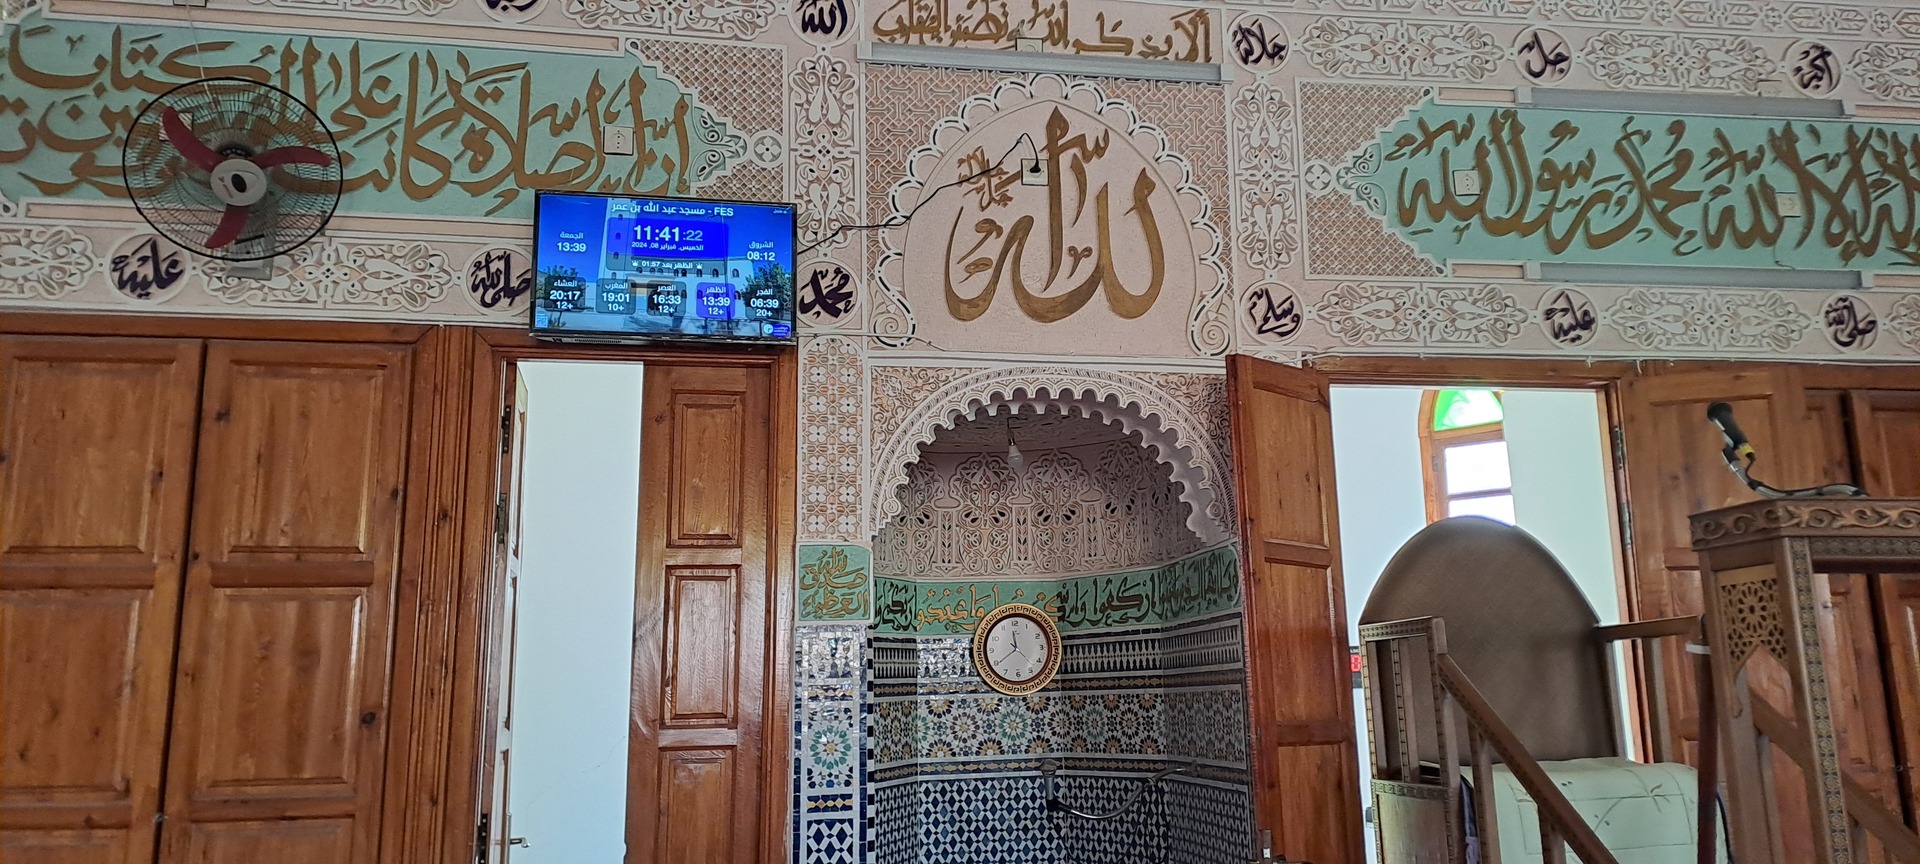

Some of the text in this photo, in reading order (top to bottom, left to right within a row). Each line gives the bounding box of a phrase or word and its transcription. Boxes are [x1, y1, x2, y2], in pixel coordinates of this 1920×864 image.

[611, 203, 628, 212] عمر
[630, 204, 641, 214] بن
[644, 202, 659, 214] الله
[661, 205, 677, 214] عبد
[678, 205, 706, 216] مسجد
[714, 208, 734, 217] FES
[944, 105, 1165, 323] الله
[560, 231, 584, 240] الجمعة
[557, 242, 587, 252] 13:39
[749, 241, 774, 250] الشروق
[747, 251, 776, 261] 08:12
[604, 282, 628, 290] المغرب
[549, 290, 581, 300] 20:17
[602, 292, 630, 302] 19:01
[652, 294, 681, 304] 16:33
[702, 297, 731, 306] 13:39
[750, 299, 779, 308] 06:39
